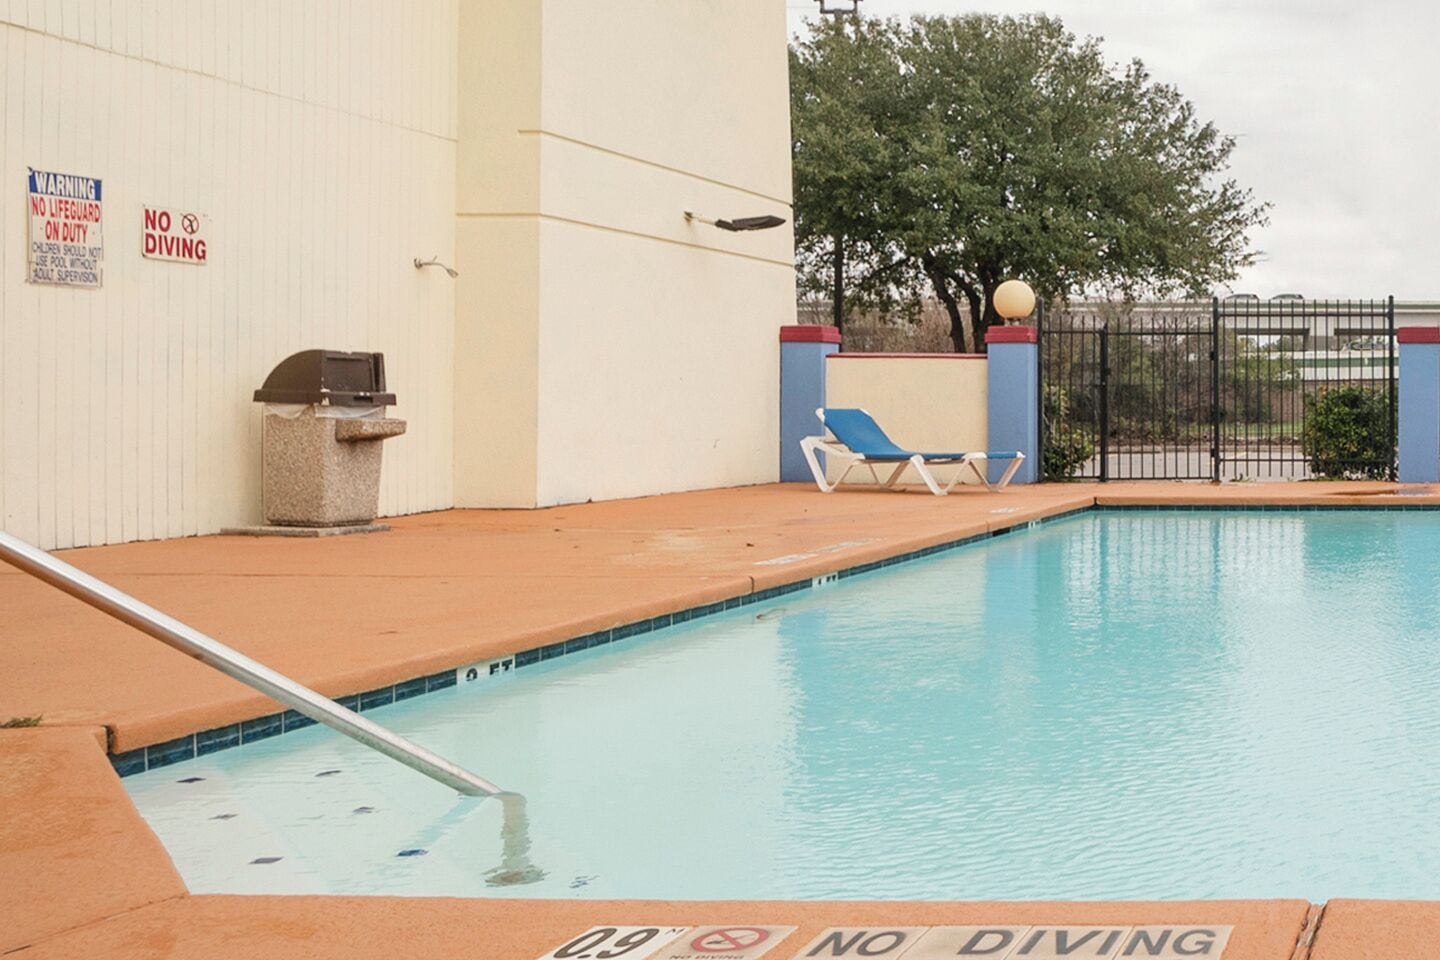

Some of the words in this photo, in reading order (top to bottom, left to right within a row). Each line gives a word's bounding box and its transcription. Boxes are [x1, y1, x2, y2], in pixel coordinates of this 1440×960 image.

[35, 171, 95, 199] WARNING
[31, 196, 46, 217] NO
[51, 198, 100, 223] LIFEGUARD
[145, 208, 171, 232] NO
[45, 221, 59, 241] ON
[62, 222, 88, 243] DUTY
[32, 241, 60, 255] CHILDREN
[63, 243, 86, 257] SHOULD
[89, 246, 101, 258] NOT
[145, 233, 206, 260] DIVING
[33, 267, 54, 282] ADULT
[57, 269, 98, 283] SUPERVISION
[36, 255, 48, 267] USE
[51, 255, 67, 269] POOL
[70, 257, 97, 271] WITHOUT
[553, 928, 660, 959] 0.9
[806, 930, 906, 956] NO
[957, 929, 1217, 956] DIVING
